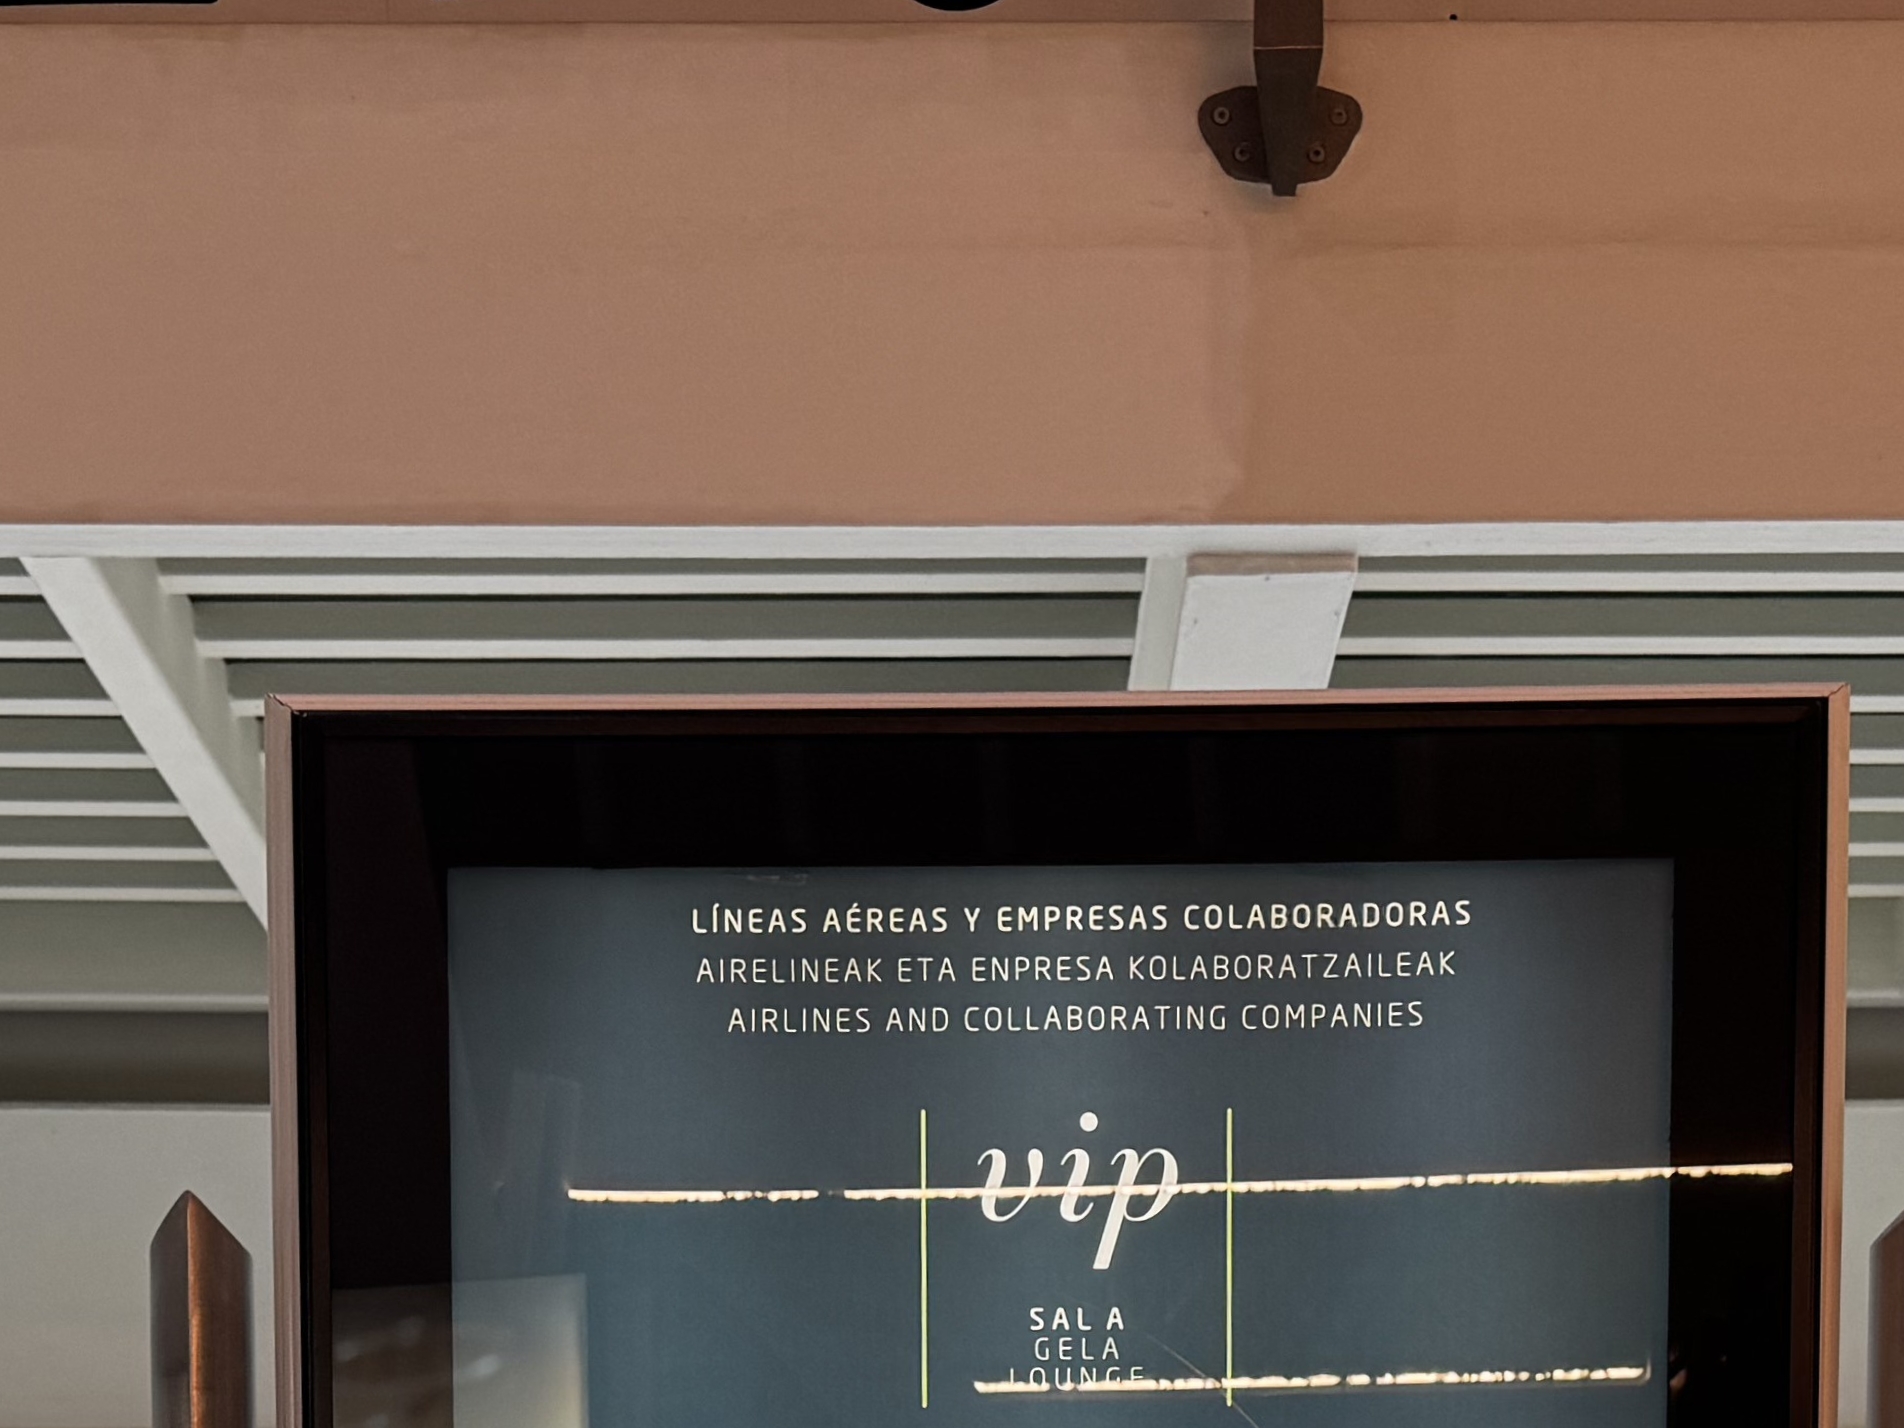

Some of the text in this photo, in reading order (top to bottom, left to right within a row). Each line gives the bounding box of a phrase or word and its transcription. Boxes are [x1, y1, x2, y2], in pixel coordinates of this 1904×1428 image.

[692, 899, 1471, 934] LÍNEAS AÉREAS Y EMPRESAS COLABORADORAS
[696, 950, 1455, 984] AIRELINEAK ETA ENPRESA KOLABORATZAILEAK
[727, 1000, 1423, 1033] AIRLINES AND COLLABORATING COMPANIES
[976, 1111, 1181, 1270] vip
[1034, 1336, 1119, 1361] GELA
